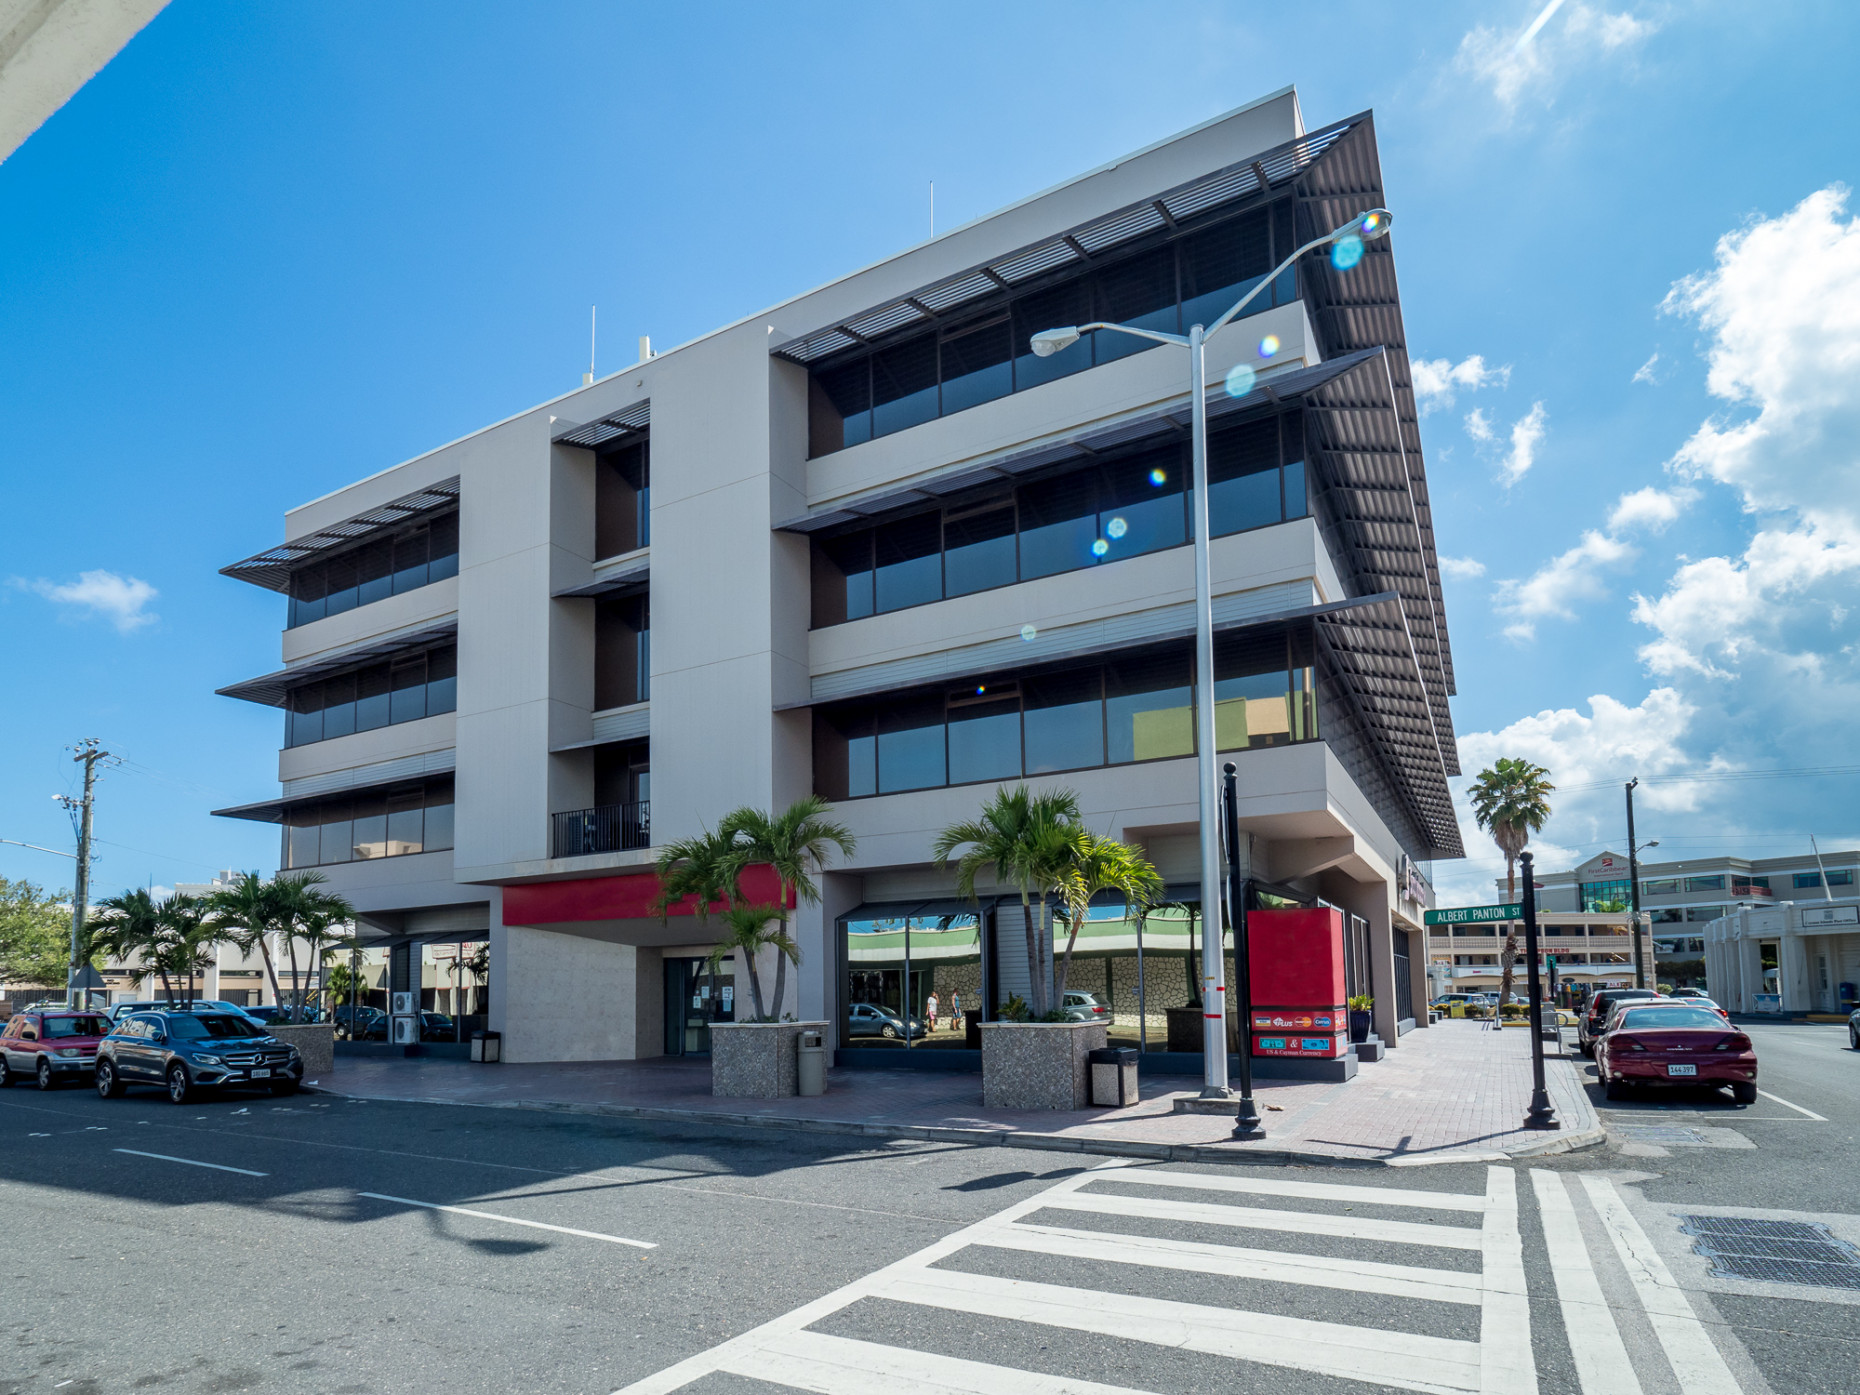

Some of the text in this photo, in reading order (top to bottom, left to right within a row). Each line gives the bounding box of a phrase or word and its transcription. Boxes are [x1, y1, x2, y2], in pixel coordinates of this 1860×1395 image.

[1437, 907, 1520, 922] ALBERT PANTON ST
[1290, 1039, 1298, 1048] &
